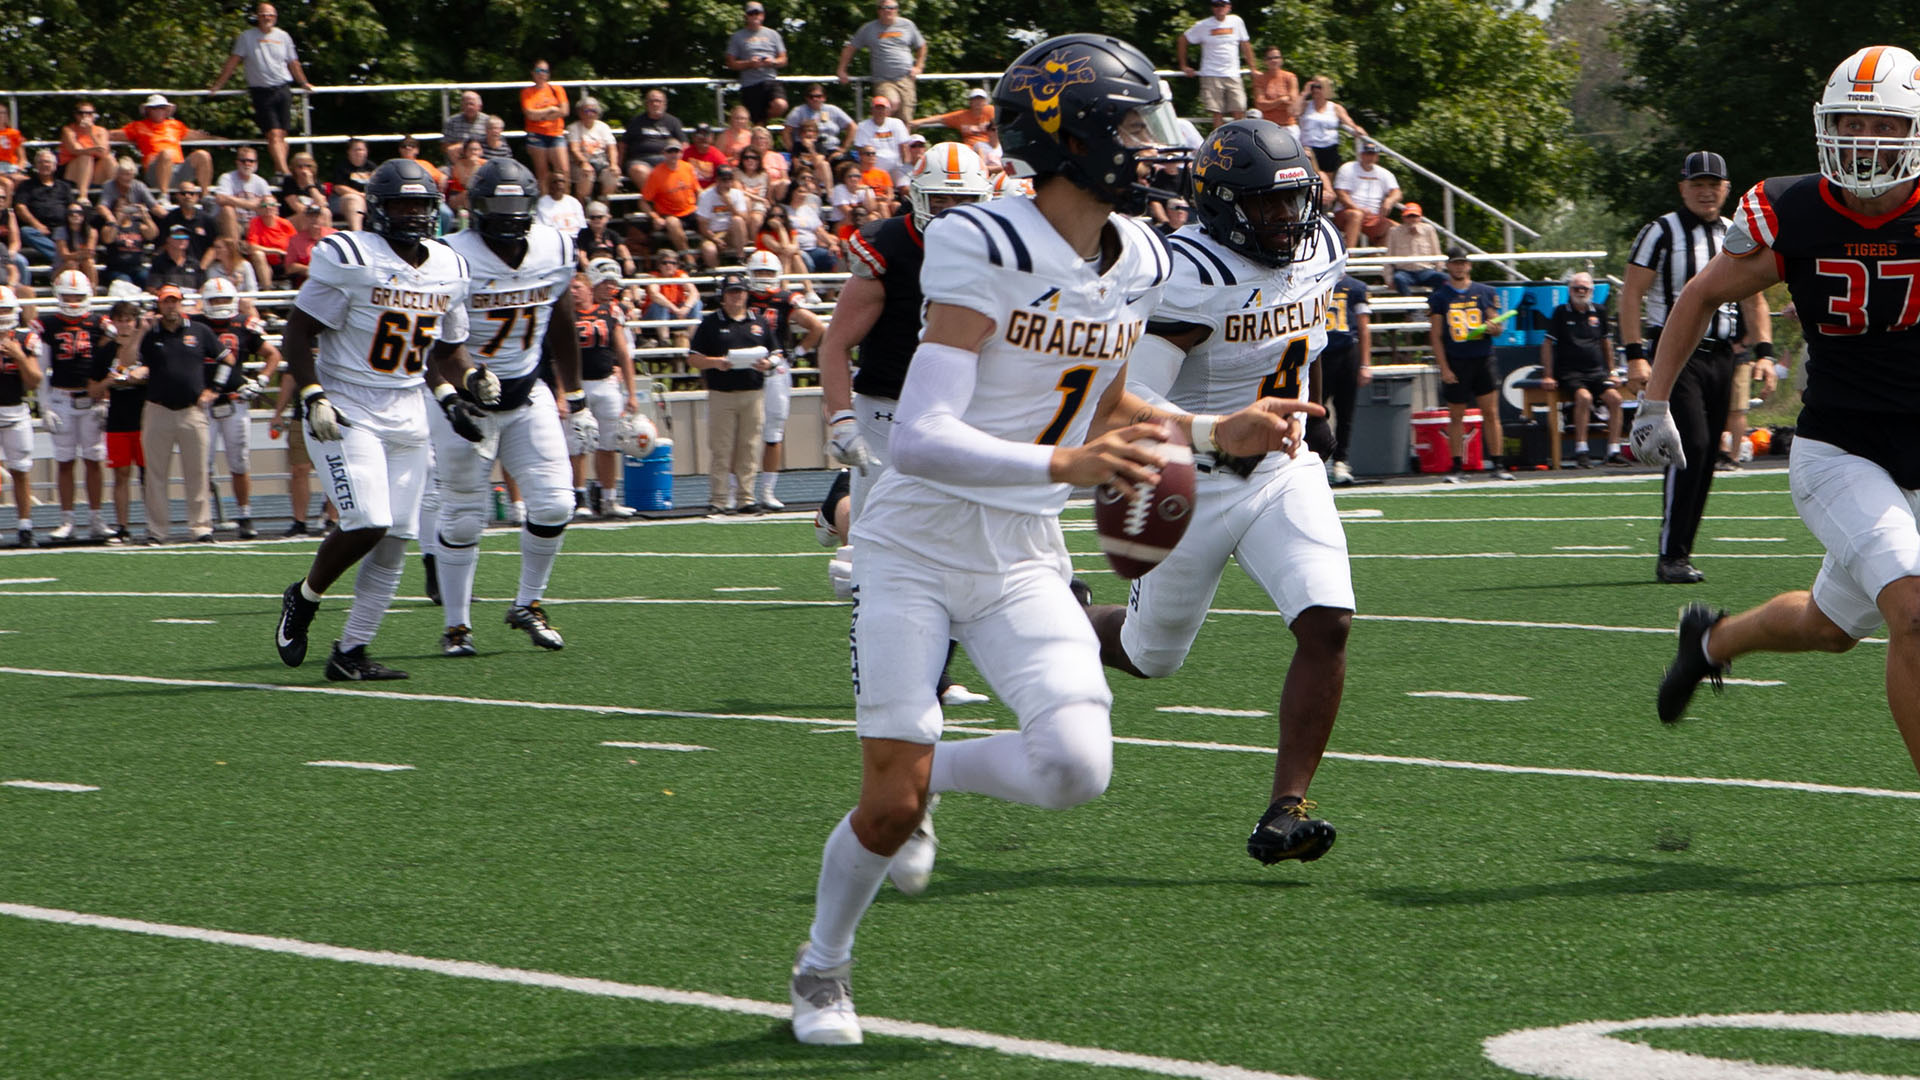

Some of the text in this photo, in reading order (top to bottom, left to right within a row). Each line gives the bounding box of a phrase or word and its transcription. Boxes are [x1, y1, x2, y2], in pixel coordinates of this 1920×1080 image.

[1847, 94, 1875, 102] TIGERS
[1279, 170, 1305, 180] Riddell
[1844, 243, 1897, 256] TIGERS
[1816, 258, 1920, 336] 37
[368, 310, 439, 376] 65
[479, 305, 537, 358] 71
[574, 320, 609, 348] 31
[1255, 335, 1309, 401] 4
[1034, 364, 1100, 447] 1
[325, 454, 355, 511] JACKETS
